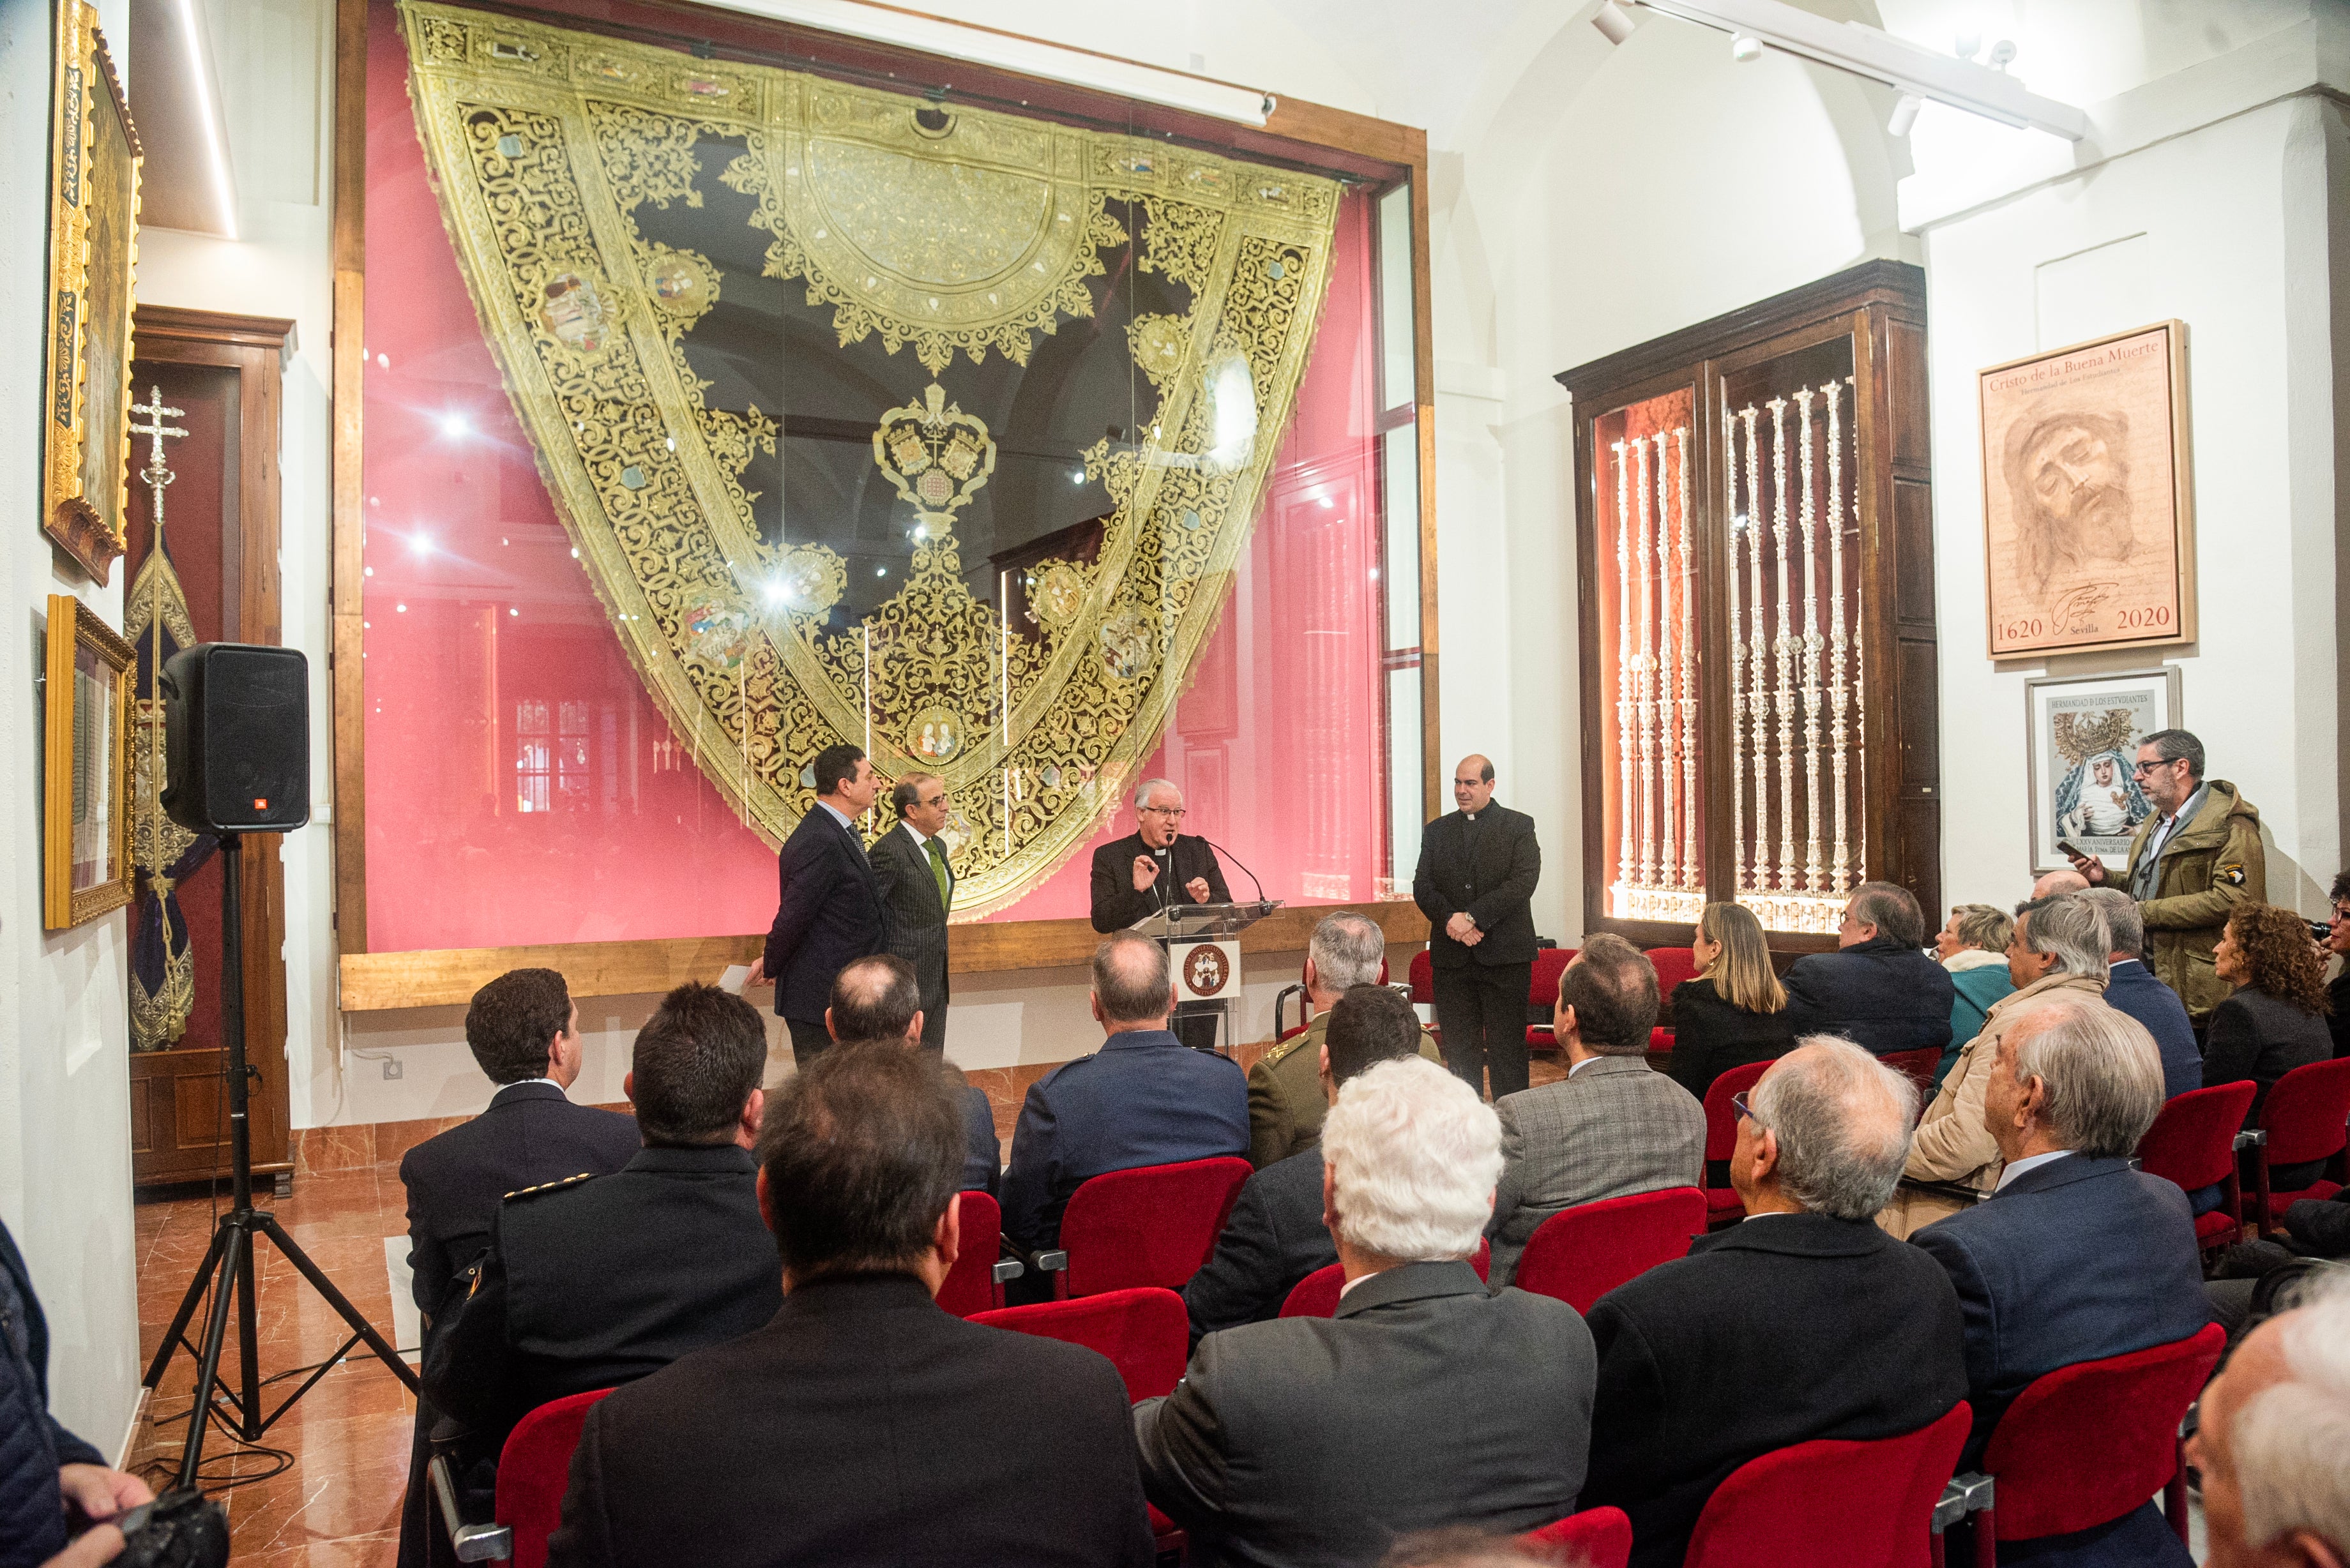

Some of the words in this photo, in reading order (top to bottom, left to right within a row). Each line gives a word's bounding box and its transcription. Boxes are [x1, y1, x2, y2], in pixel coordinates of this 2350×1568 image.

[1990, 375, 2027, 392] Cristo
[2031, 368, 2045, 381] de
[2050, 364, 2060, 377] la
[2065, 358, 2104, 373] Buena
[2108, 342, 2158, 363] Muerte
[2020, 381, 2058, 395] Hermandad
[2082, 368, 2121, 381] Estudiantes
[2117, 606, 2170, 629] 2020
[1997, 618, 2042, 640] 1620
[2070, 623, 2099, 635] Sevilla
[2051, 698, 2088, 709] HERMANDAD
[2095, 697, 2106, 705] LOS
